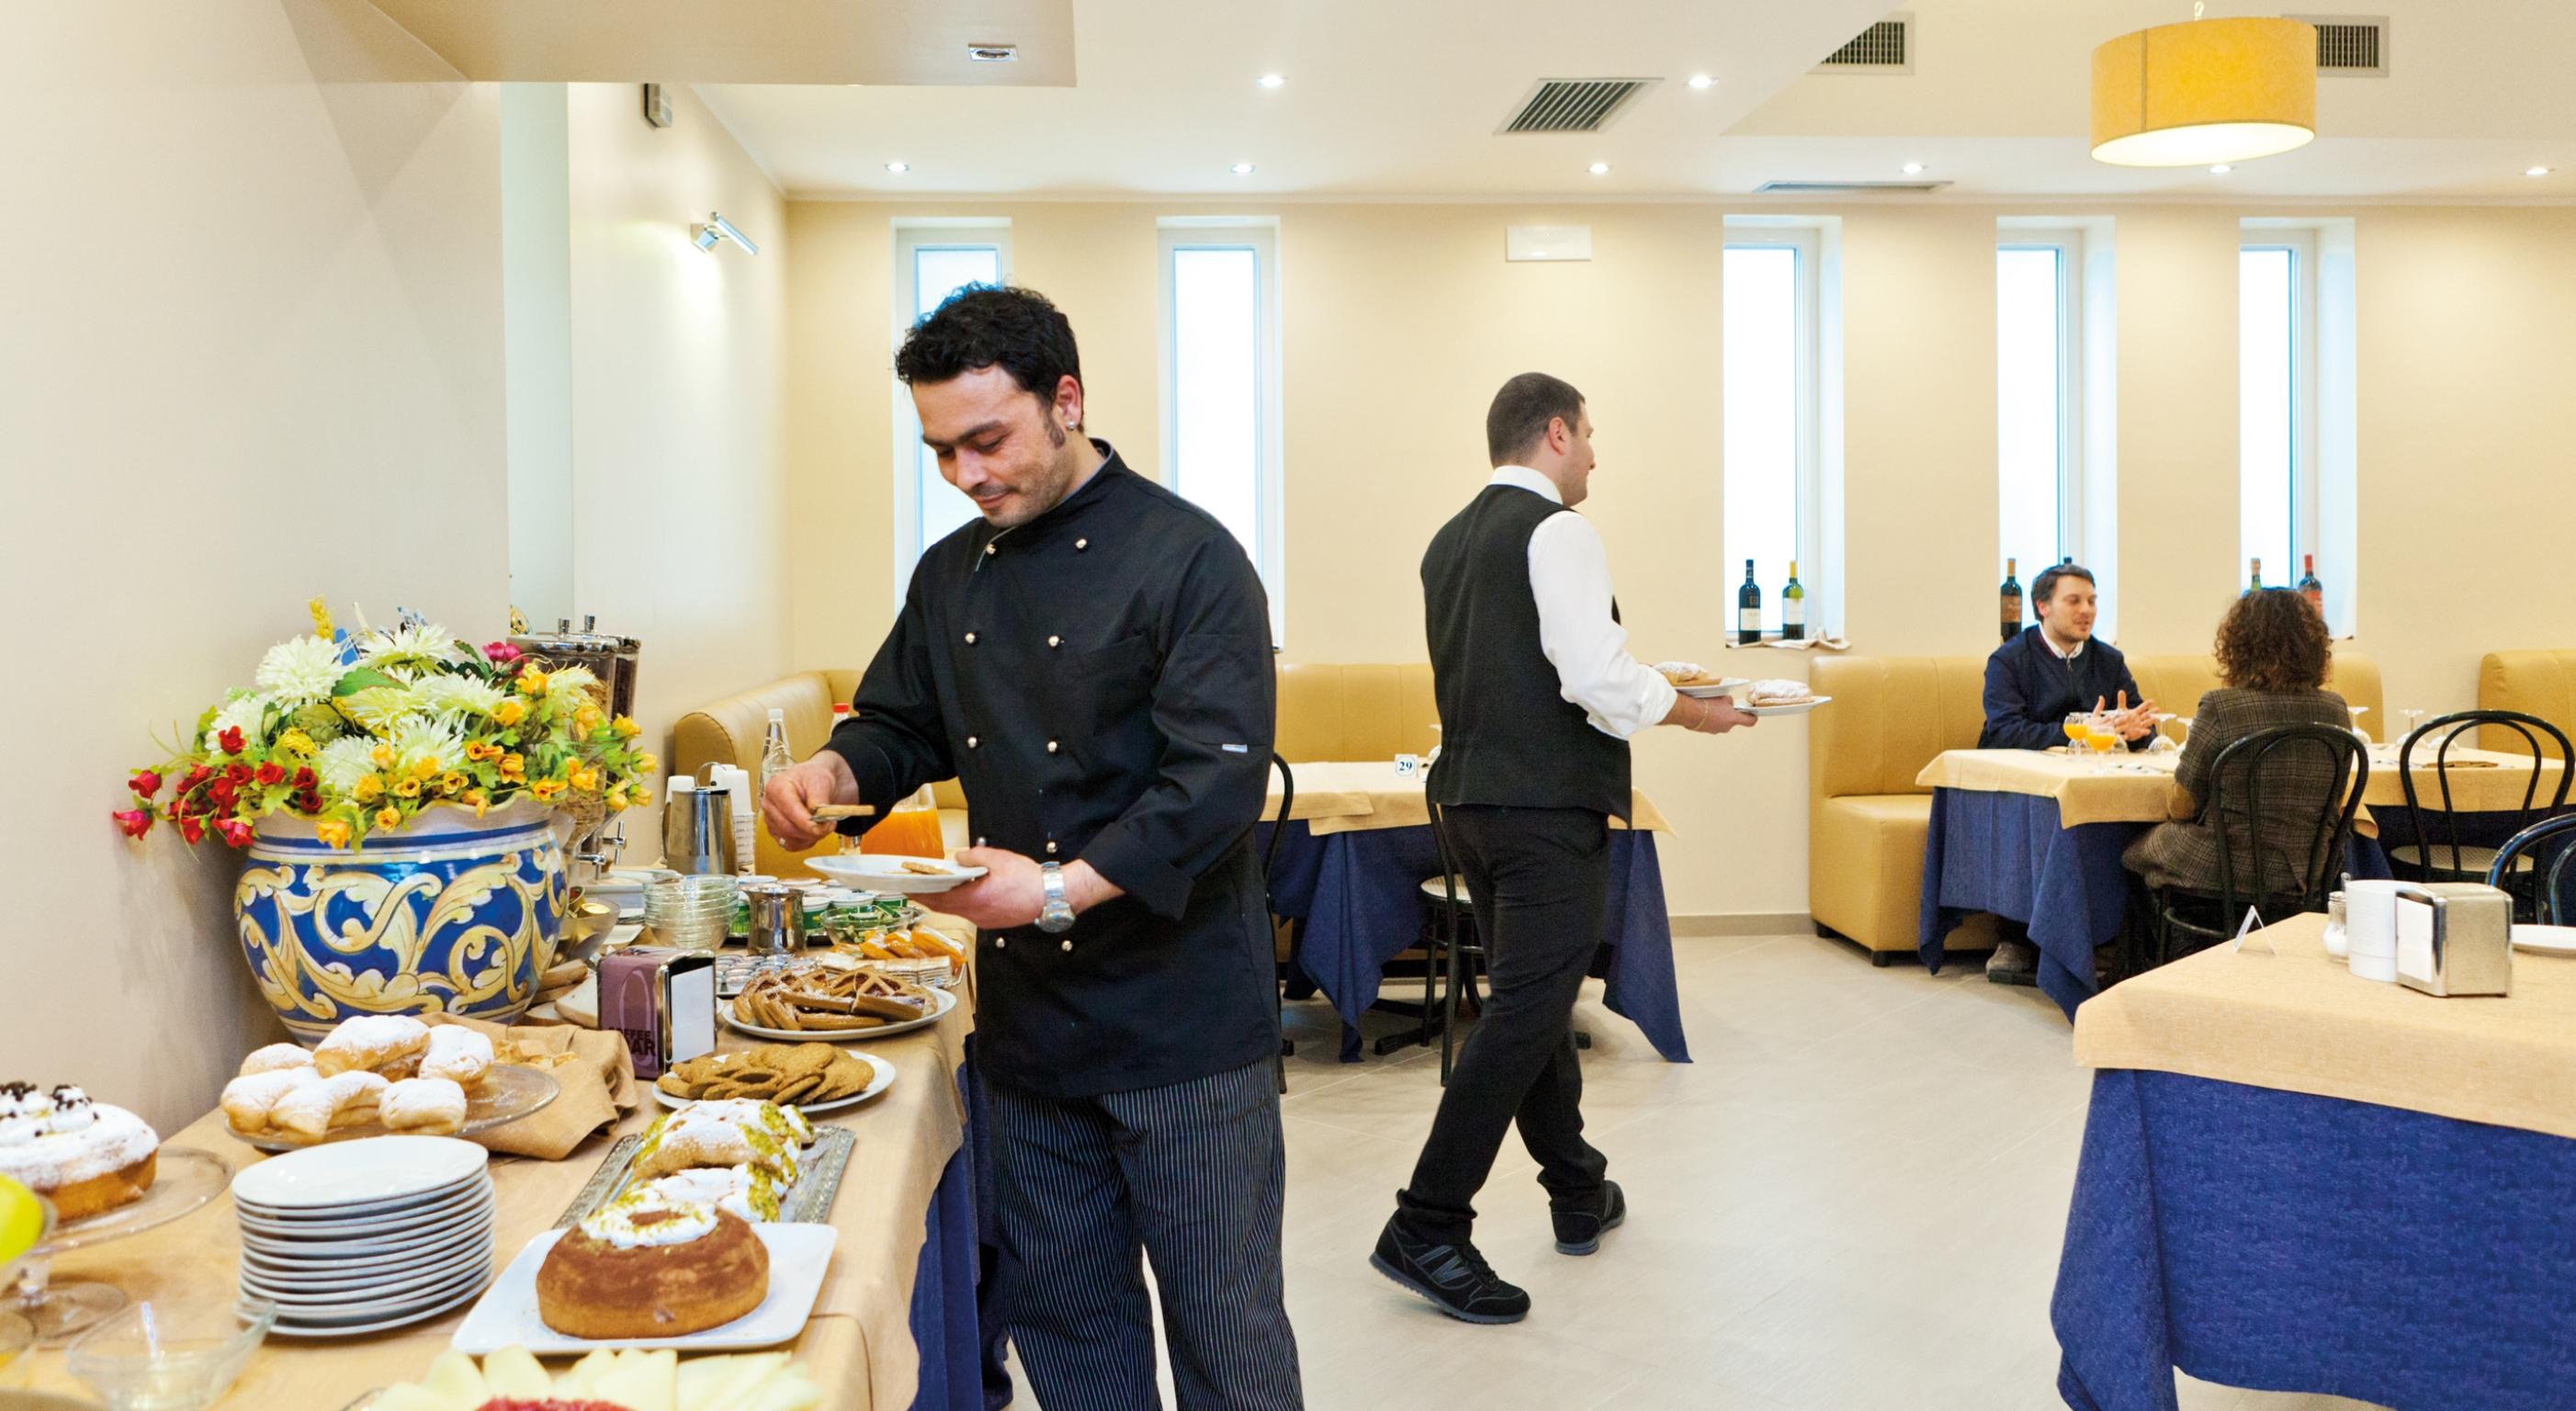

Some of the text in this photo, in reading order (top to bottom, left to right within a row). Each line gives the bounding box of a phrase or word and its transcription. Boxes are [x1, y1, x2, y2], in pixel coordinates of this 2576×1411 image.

[1398, 761, 1413, 772] 29
[609, 1026, 651, 1042] FFEE
[627, 1038, 657, 1056] AR
